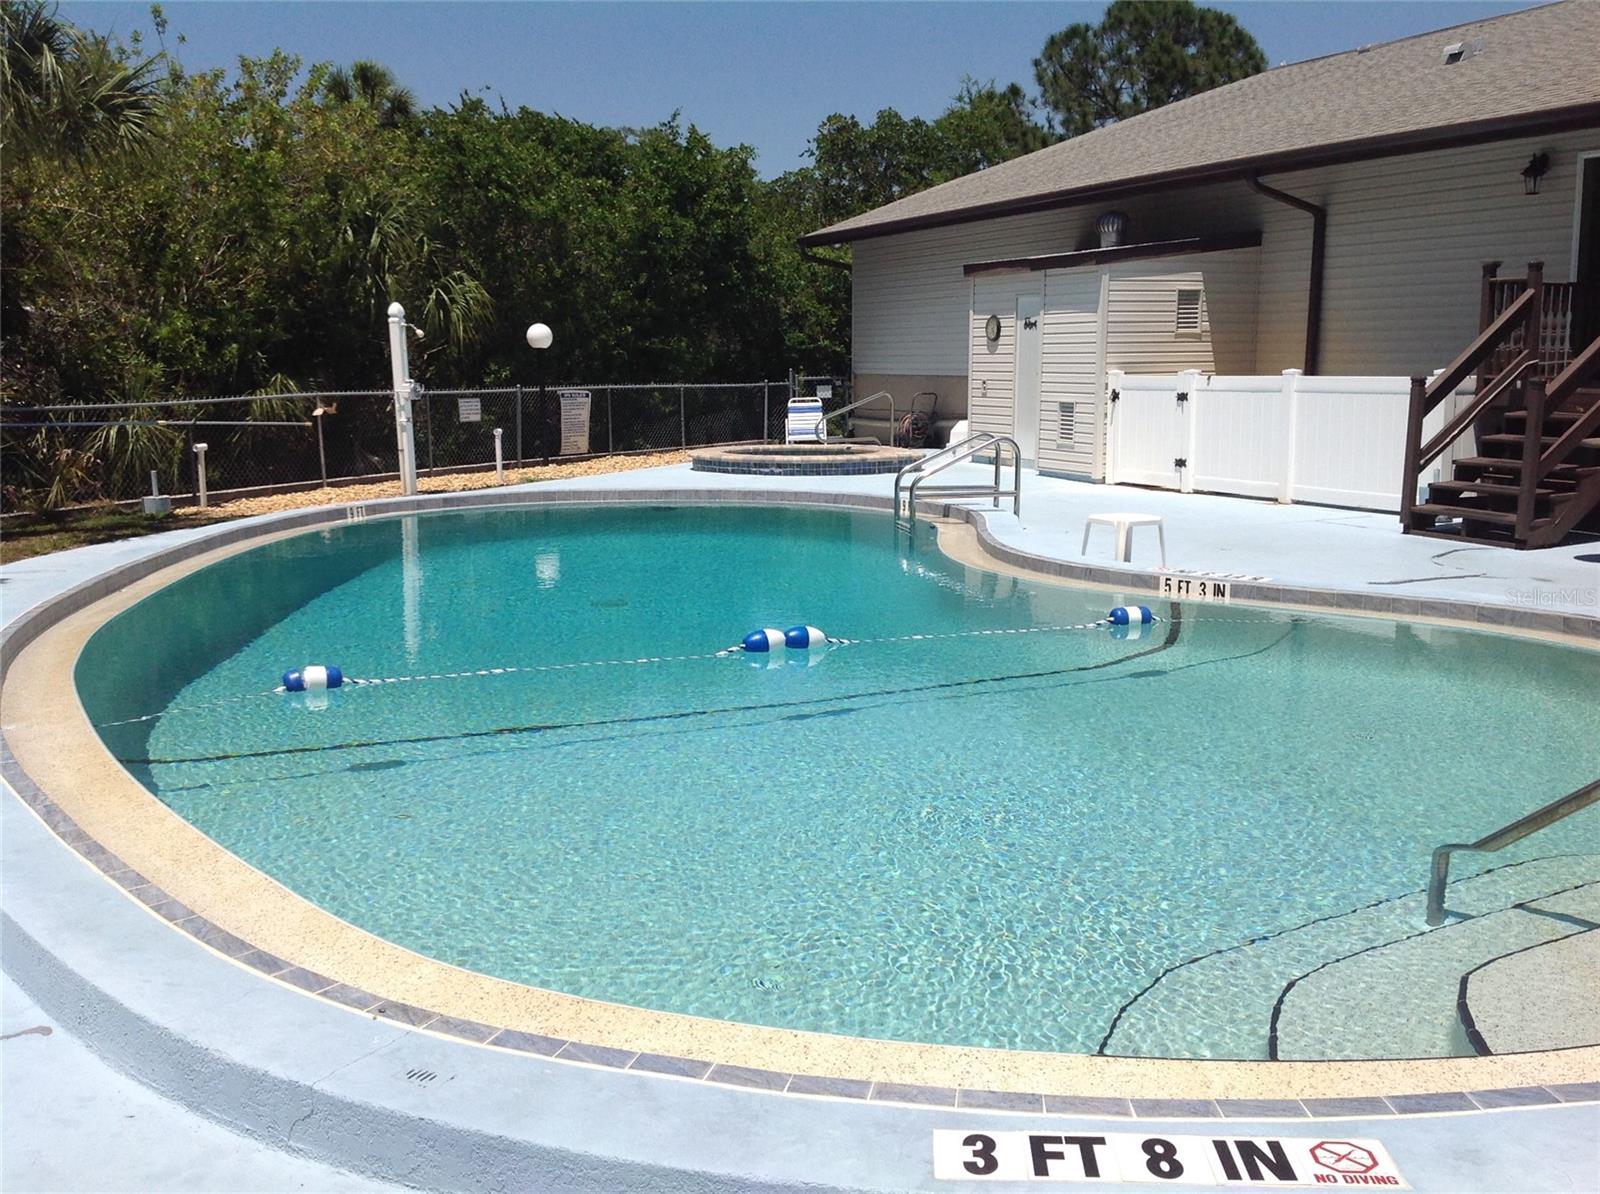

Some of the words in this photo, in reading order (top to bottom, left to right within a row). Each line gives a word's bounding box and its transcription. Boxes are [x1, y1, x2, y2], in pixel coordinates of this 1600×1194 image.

[1164, 577, 1172, 593] 5
[1177, 580, 1192, 595] FT
[1199, 582, 1207, 596] 3
[1213, 583, 1226, 598] IN
[962, 1133, 999, 1175] 3
[1028, 1135, 1106, 1178] FT
[1141, 1138, 1184, 1179] 8
[1212, 1139, 1299, 1182] IN
[1313, 1173, 1338, 1183] NO
[1342, 1174, 1399, 1185] DIVING
